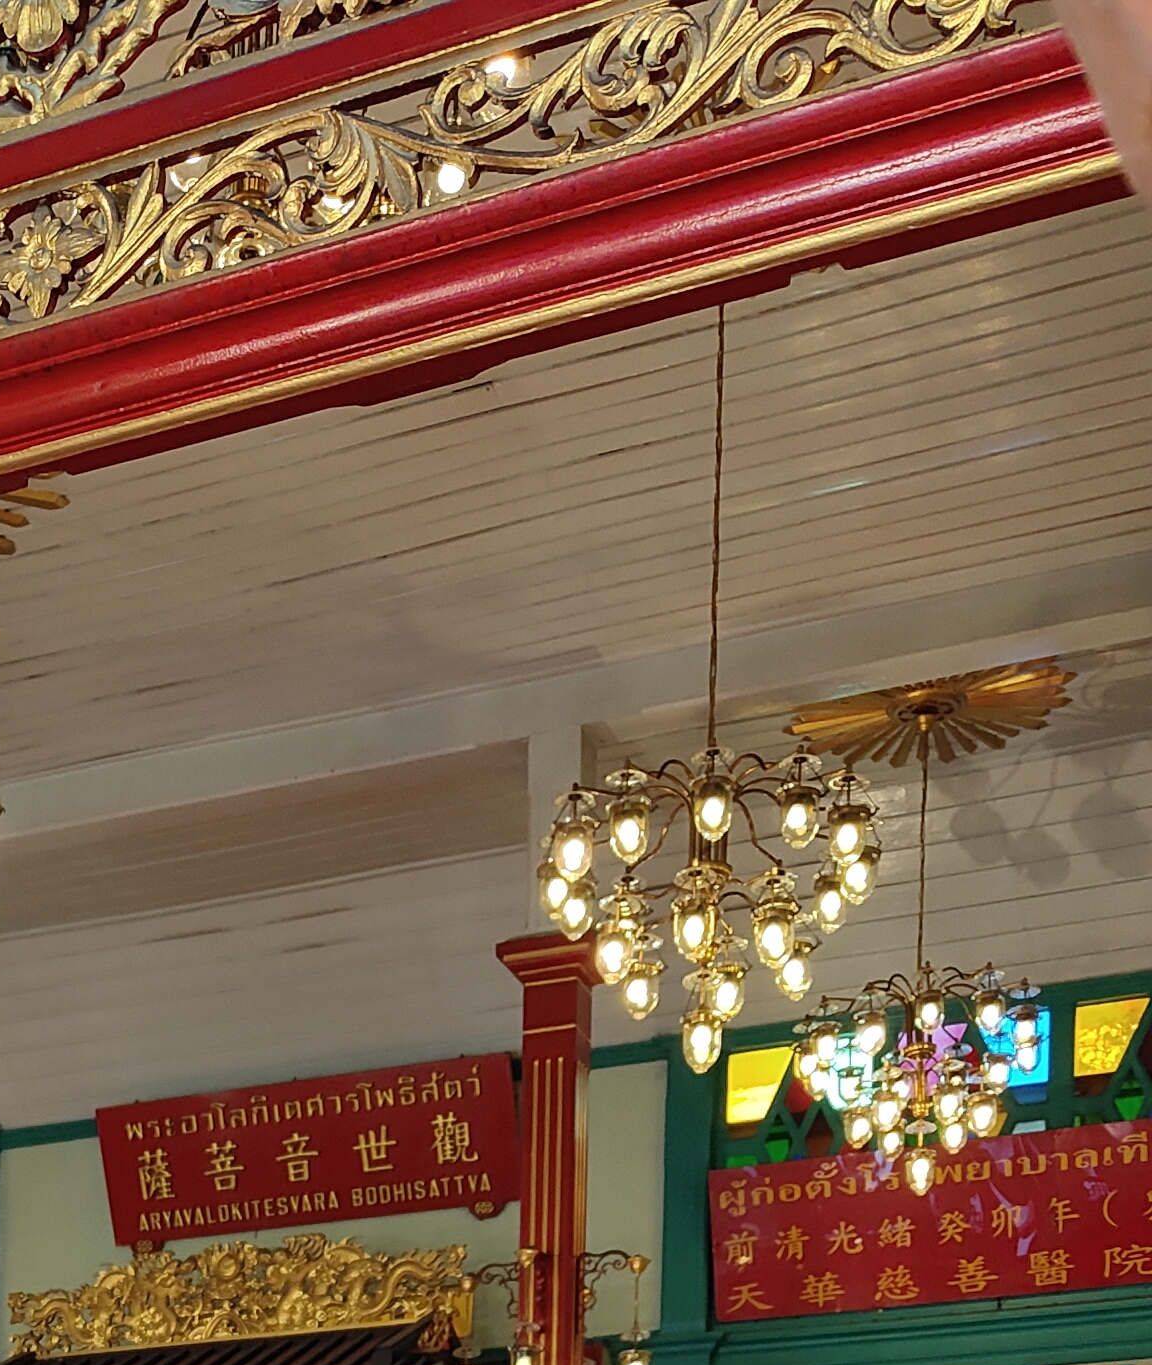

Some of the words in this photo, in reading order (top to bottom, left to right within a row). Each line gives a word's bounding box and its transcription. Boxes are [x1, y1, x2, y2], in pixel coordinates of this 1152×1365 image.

[138, 1193, 340, 1232] ARYAVALOKITESVARA
[352, 1172, 492, 1207] BODHISATTVA
[726, 1244, 1152, 1314] 天華慈善醫院
